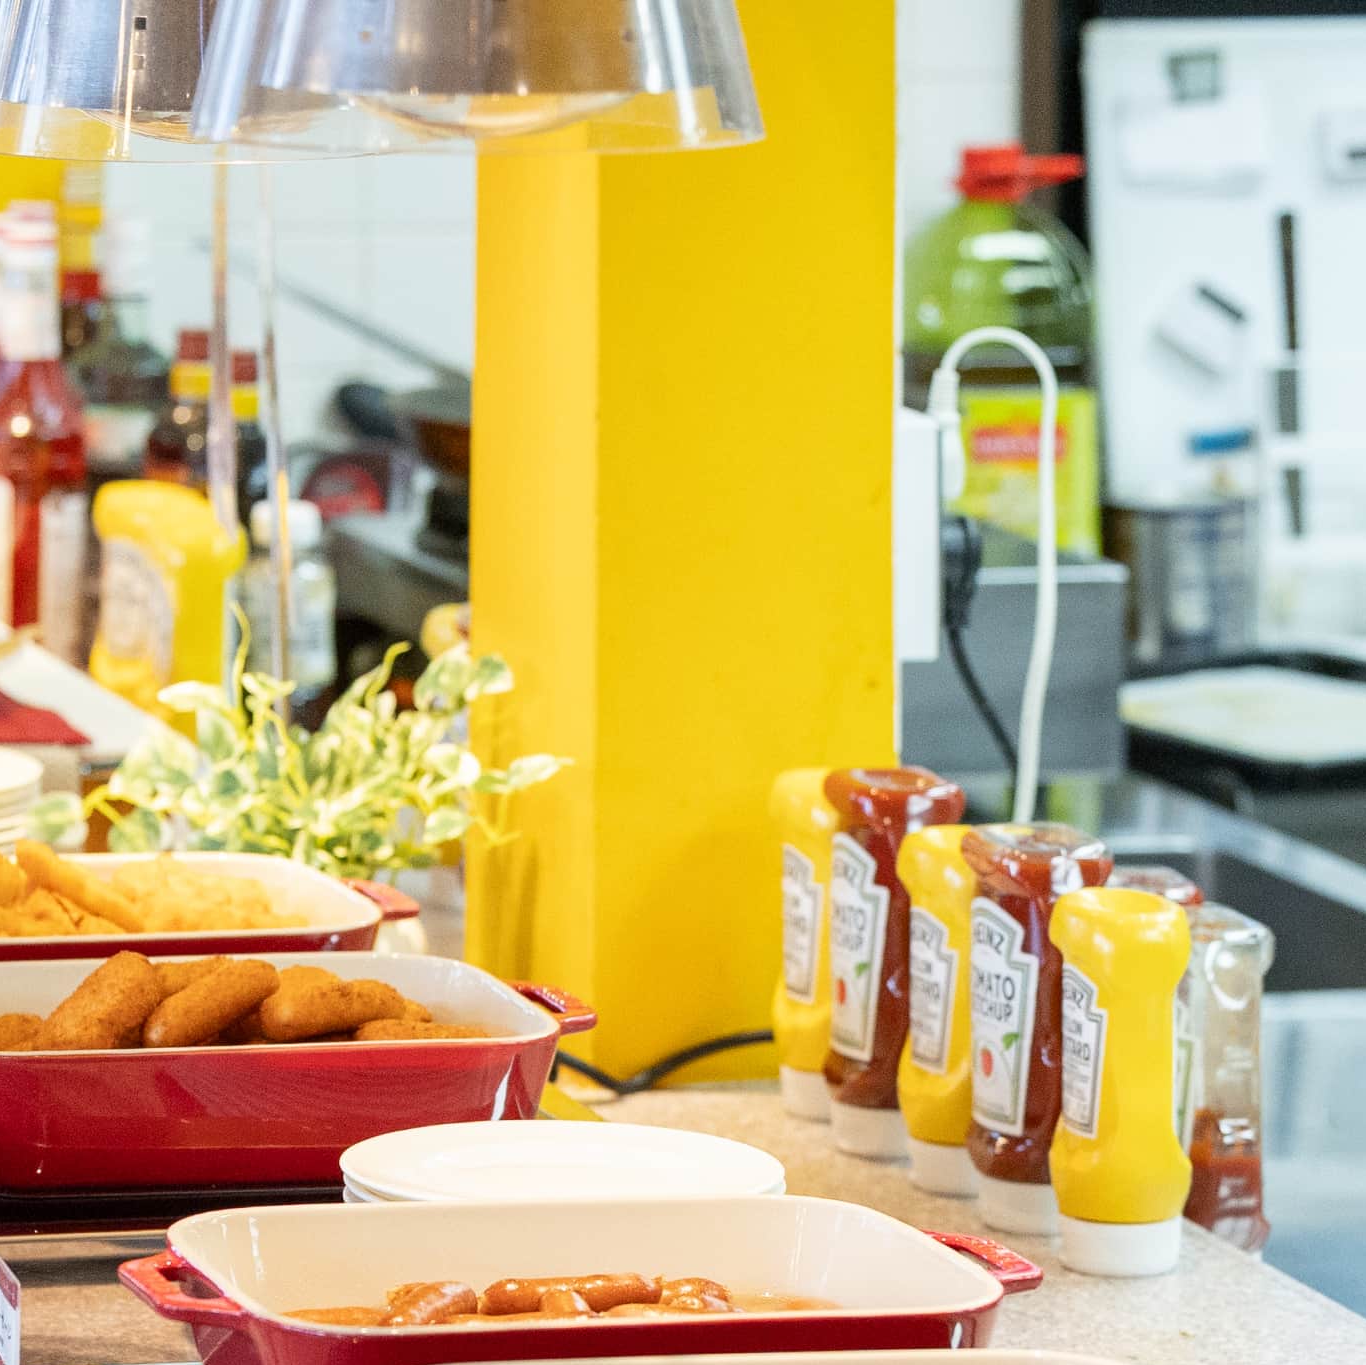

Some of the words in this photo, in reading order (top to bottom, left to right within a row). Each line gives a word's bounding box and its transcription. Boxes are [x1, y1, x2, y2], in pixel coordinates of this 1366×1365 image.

[833, 900, 867, 931] MATO
[972, 964, 1015, 1001] MATO
[973, 990, 1013, 1022] TCHUP
[1064, 1034, 1091, 1061] TARD
